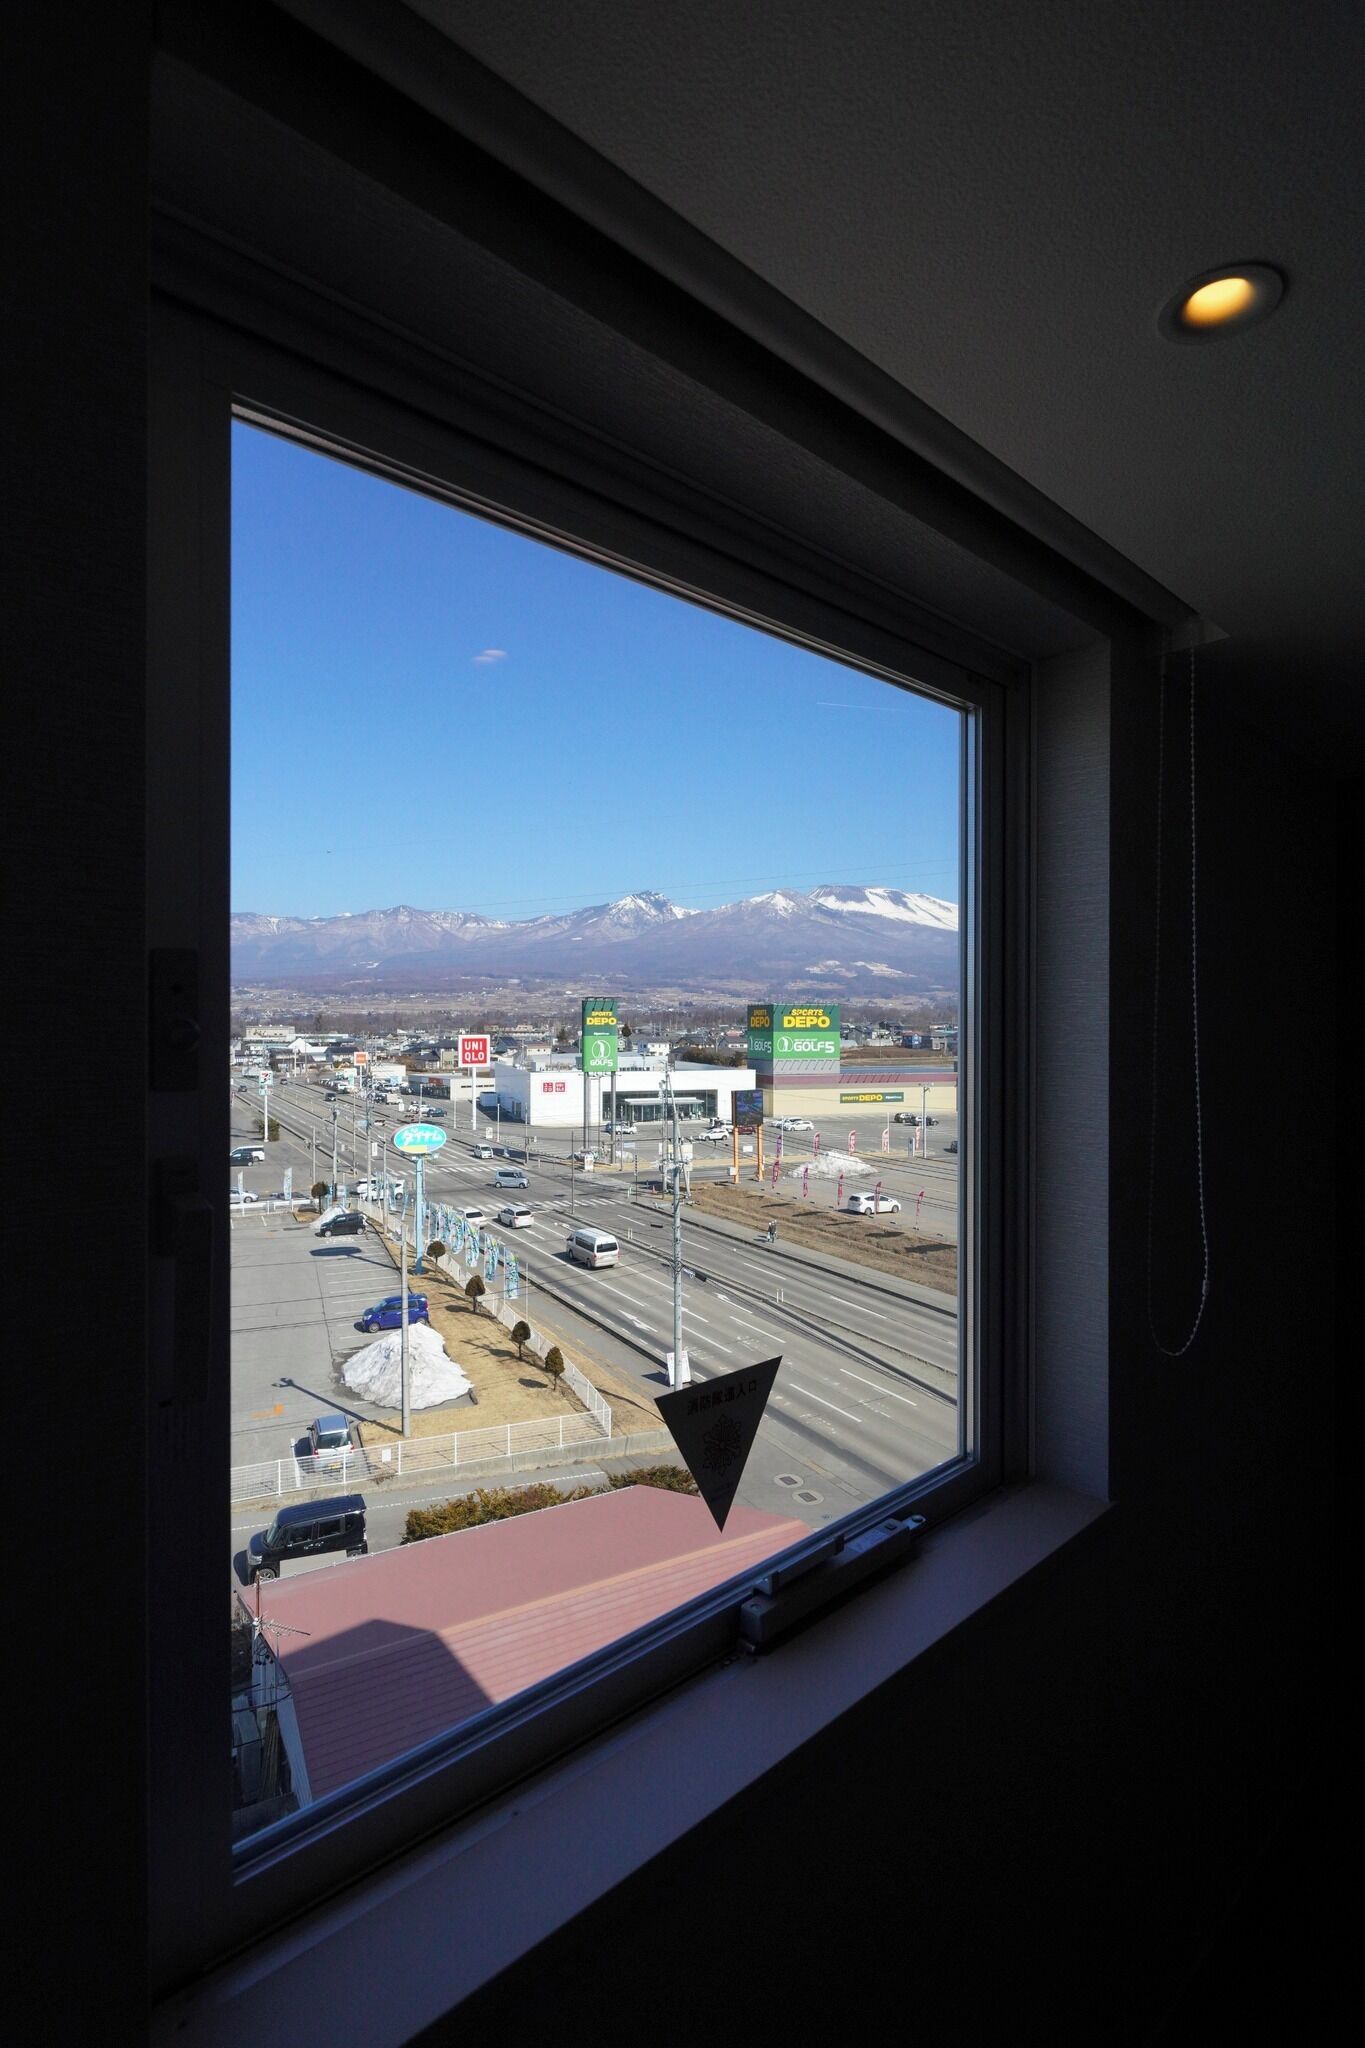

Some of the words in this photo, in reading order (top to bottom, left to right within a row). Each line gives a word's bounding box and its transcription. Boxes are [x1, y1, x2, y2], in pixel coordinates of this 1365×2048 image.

[586, 1017, 617, 1025] DEPO
[750, 1016, 769, 1028] DEPO
[783, 1016, 831, 1028] DEPO
[464, 1041, 483, 1051] UNI
[794, 1041, 835, 1053] GOLF5
[464, 1051, 485, 1062] QLO
[590, 1059, 613, 1067] GOLF5
[859, 1094, 883, 1102] DEPO
